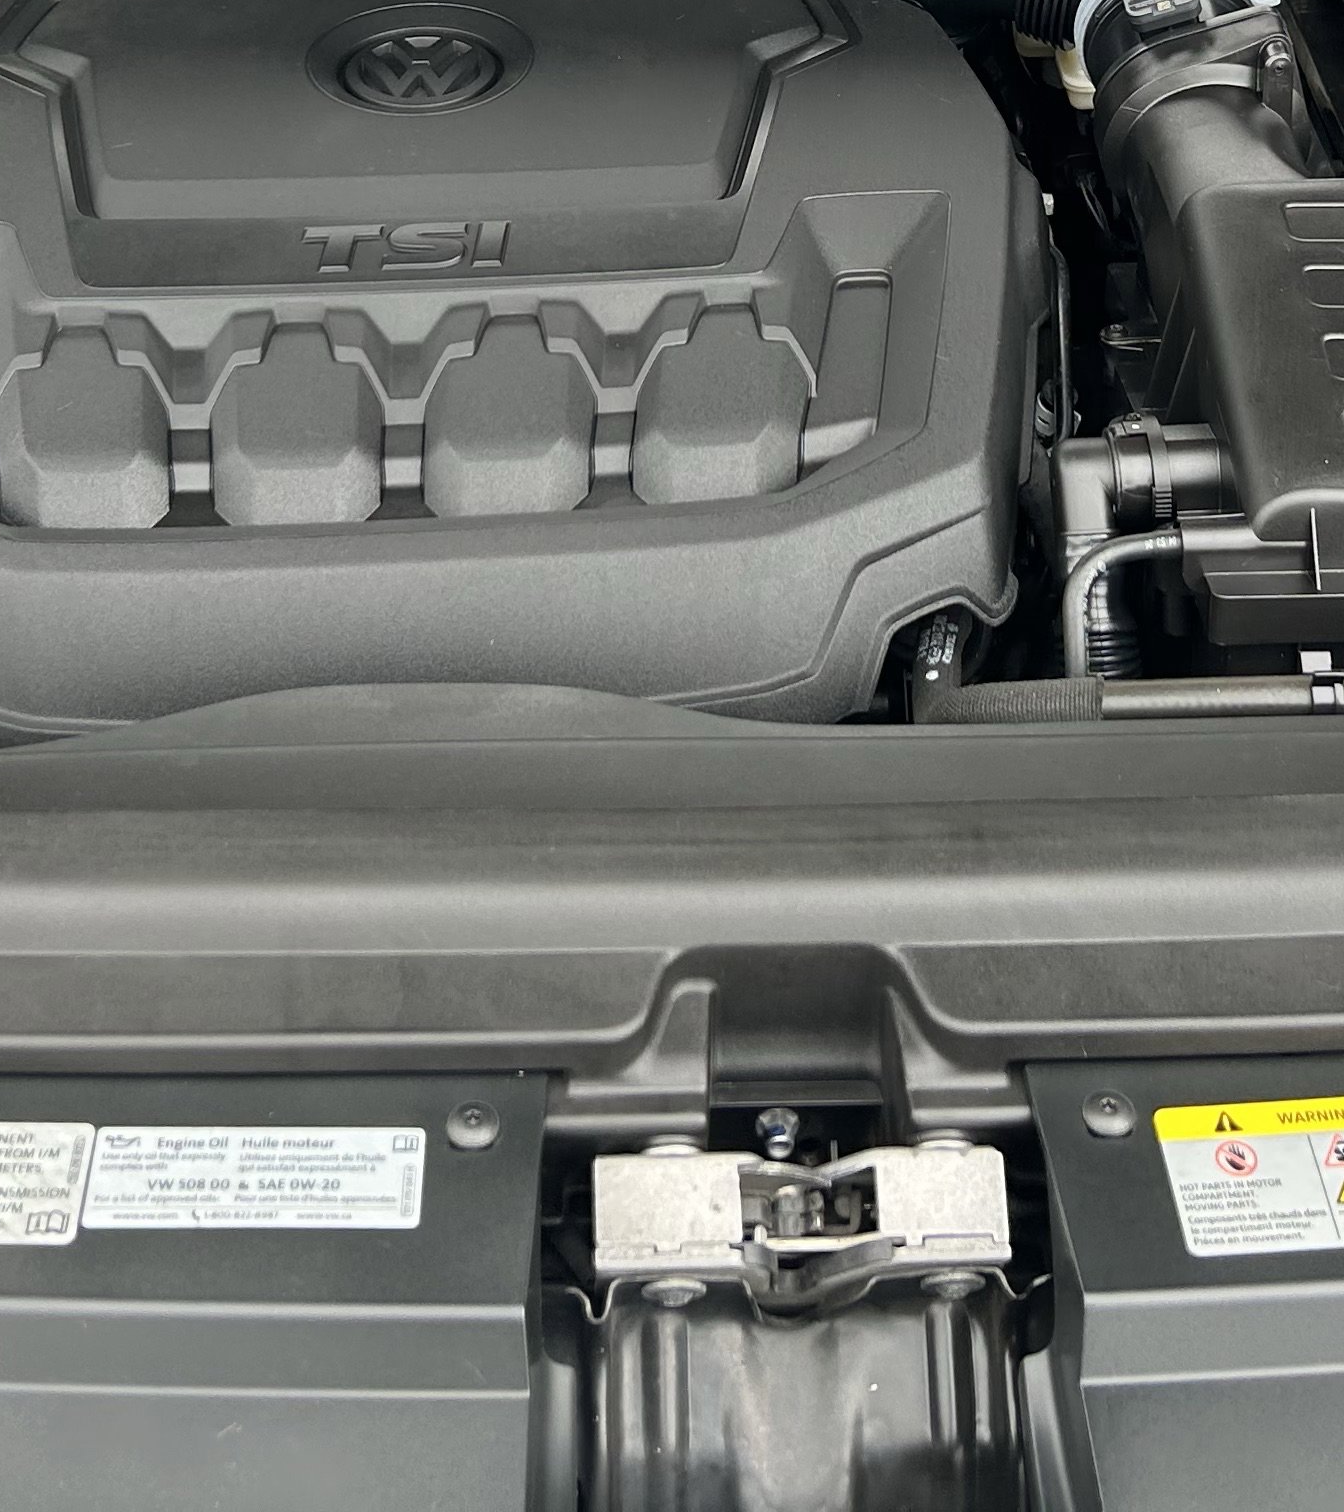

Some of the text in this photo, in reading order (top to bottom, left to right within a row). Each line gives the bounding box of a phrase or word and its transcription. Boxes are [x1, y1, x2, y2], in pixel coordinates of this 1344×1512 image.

[301, 220, 512, 274] TSI
[157, 1137, 229, 1150] Engine Oil
[241, 1137, 335, 1148] Huile moteur
[148, 1178, 174, 1189] VW
[178, 1178, 206, 1189] 508
[210, 1178, 231, 1189] 00
[258, 1178, 285, 1189] SAE
[1179, 1177, 1282, 1192] HOT PARTS IN MOTOR
[1185, 1201, 1224, 1212] MOVING
[1187, 1214, 1247, 1227] Composants
[1268, 1209, 1303, 1220] chauds
[1304, 1207, 1327, 1217] dans
[1201, 1222, 1273, 1236] compartiment
